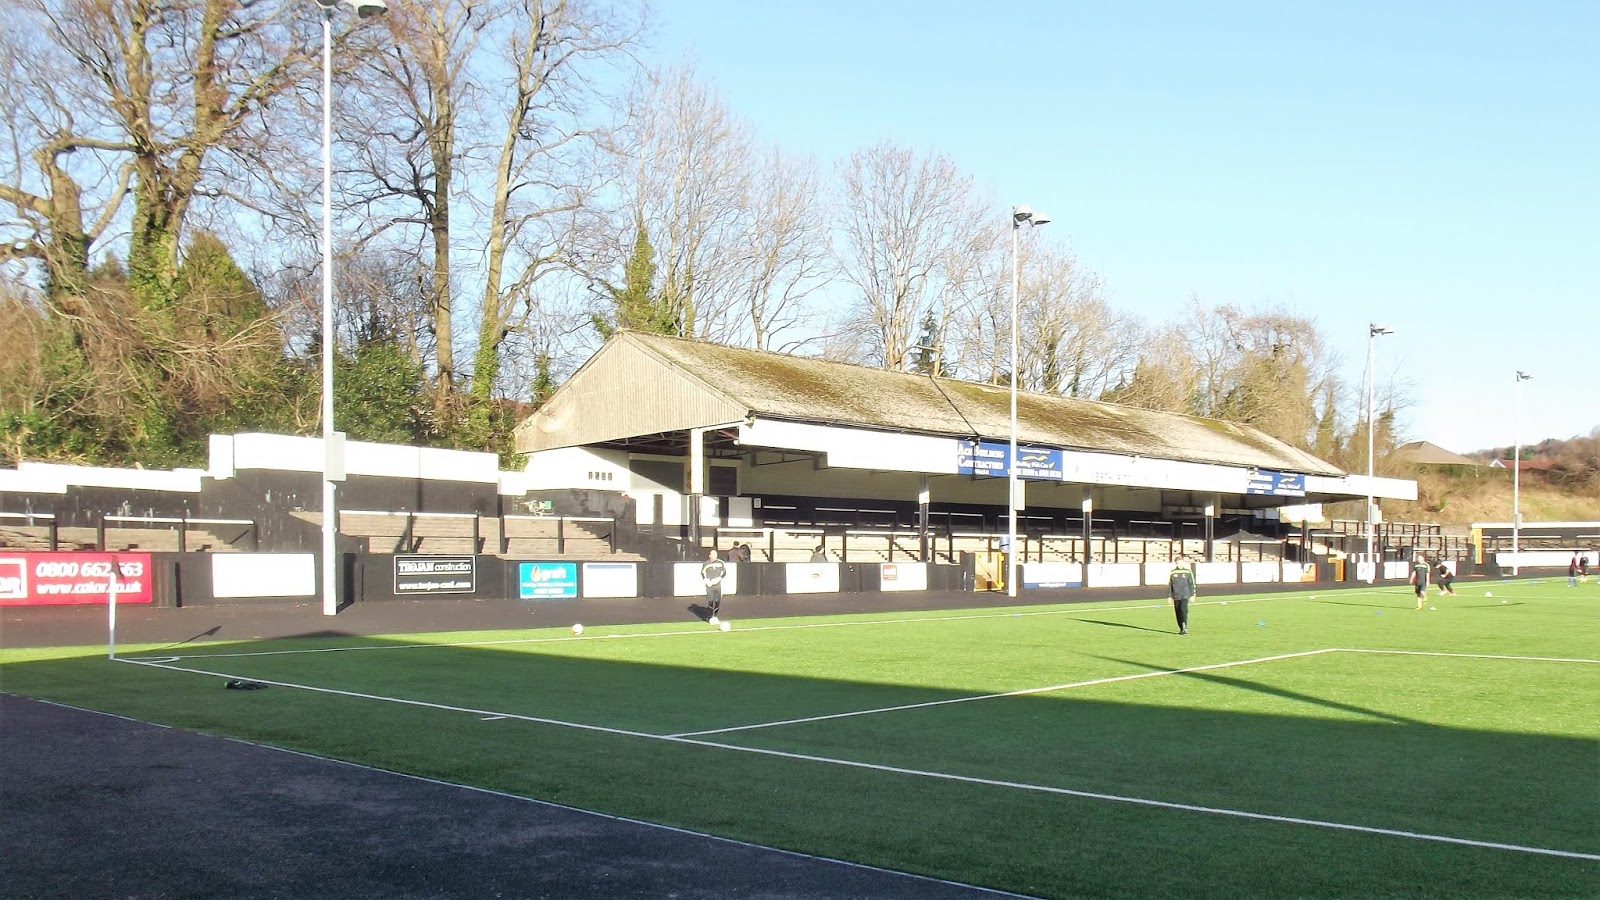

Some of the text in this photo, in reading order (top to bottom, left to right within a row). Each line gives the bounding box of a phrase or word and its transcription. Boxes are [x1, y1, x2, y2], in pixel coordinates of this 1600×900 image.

[35, 562, 80, 577] 0800
[398, 562, 472, 572] TROJAN construction
[36, 581, 142, 594] www.calor.o.uk
